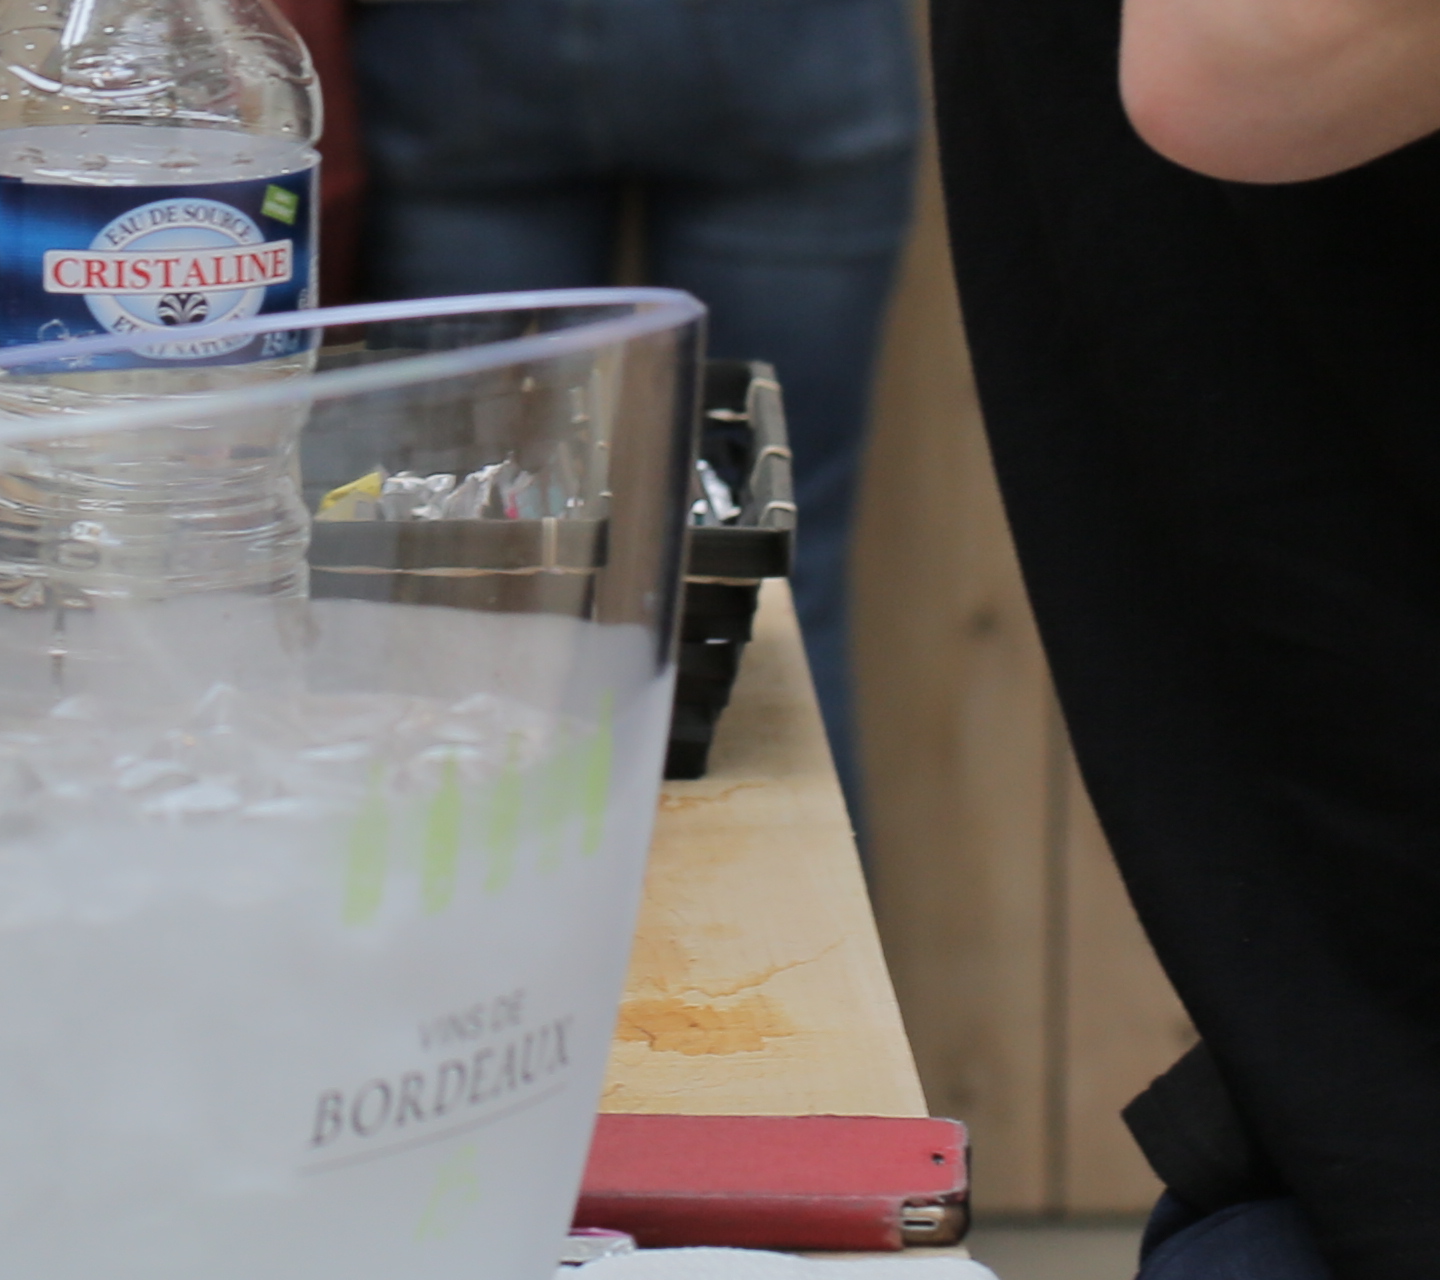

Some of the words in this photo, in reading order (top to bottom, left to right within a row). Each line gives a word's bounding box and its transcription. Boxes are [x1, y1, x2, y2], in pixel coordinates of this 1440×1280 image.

[104, 214, 147, 246] EAU
[151, 205, 179, 227] DE
[181, 203, 252, 243] SOURCE
[51, 247, 288, 290] CRISTALINE
[418, 1001, 486, 1052] VINS
[490, 988, 526, 1033] DE
[307, 1012, 575, 1149] BORDEAUX
